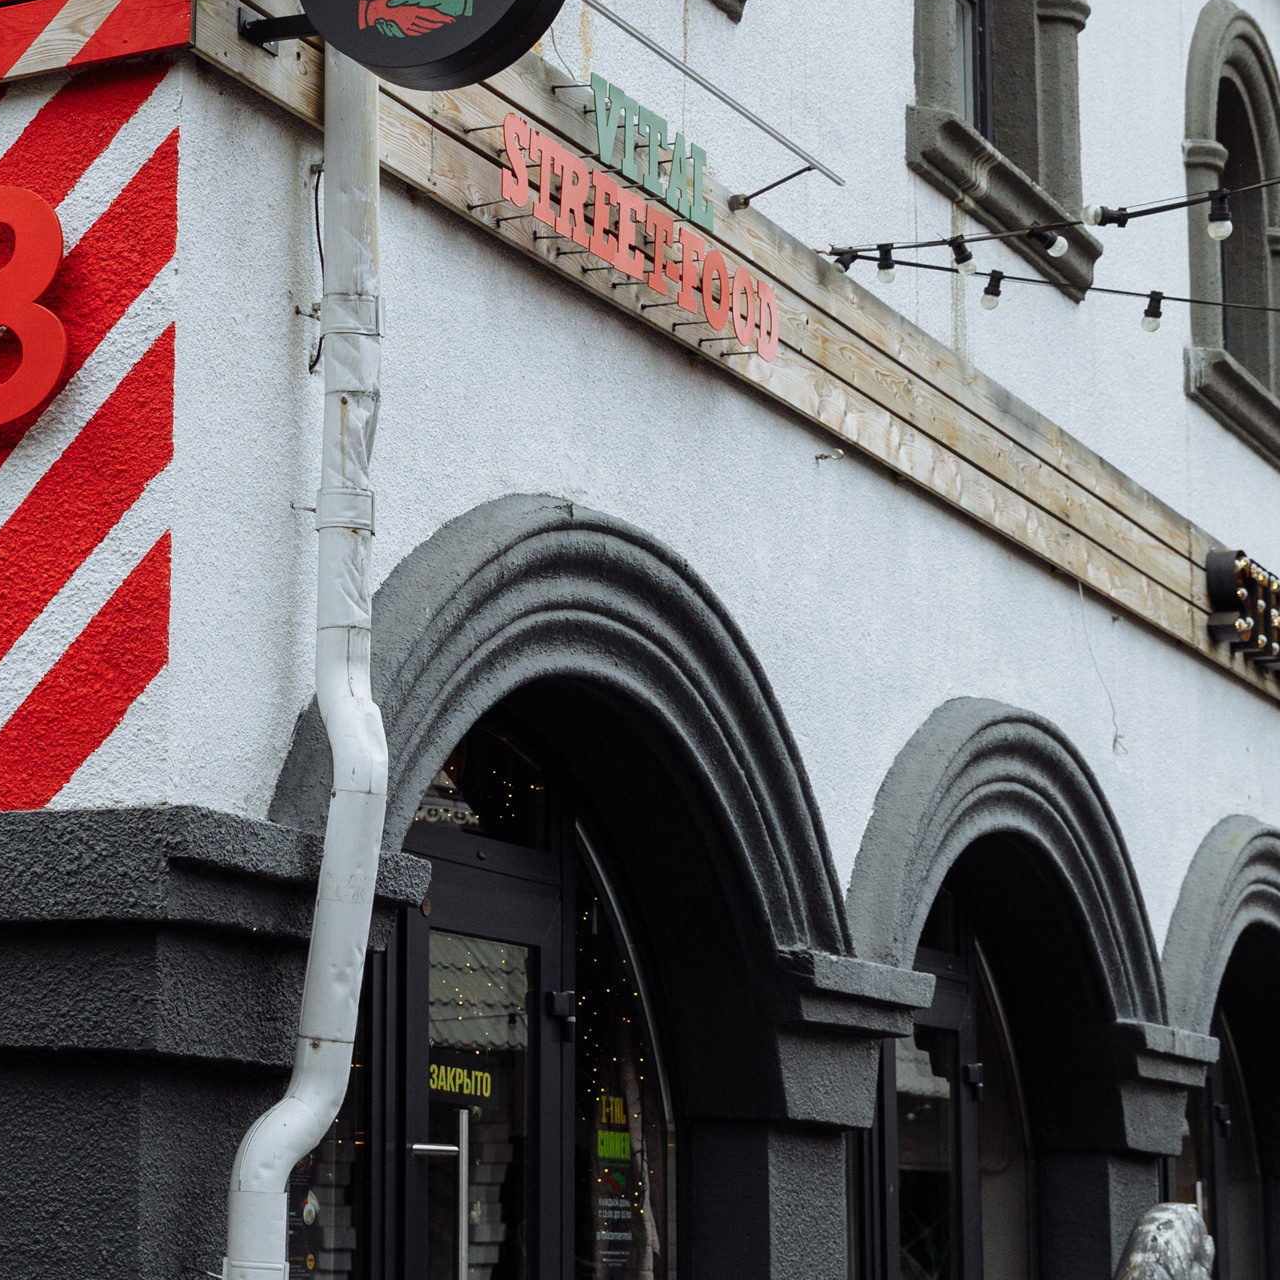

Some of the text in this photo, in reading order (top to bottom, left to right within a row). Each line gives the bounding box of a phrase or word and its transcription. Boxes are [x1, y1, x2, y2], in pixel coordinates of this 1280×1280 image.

[590, 72, 714, 233] VITAL
[501, 112, 779, 363] STREET-FOOD
[429, 1063, 492, 1098] ЗАКРЫТО
